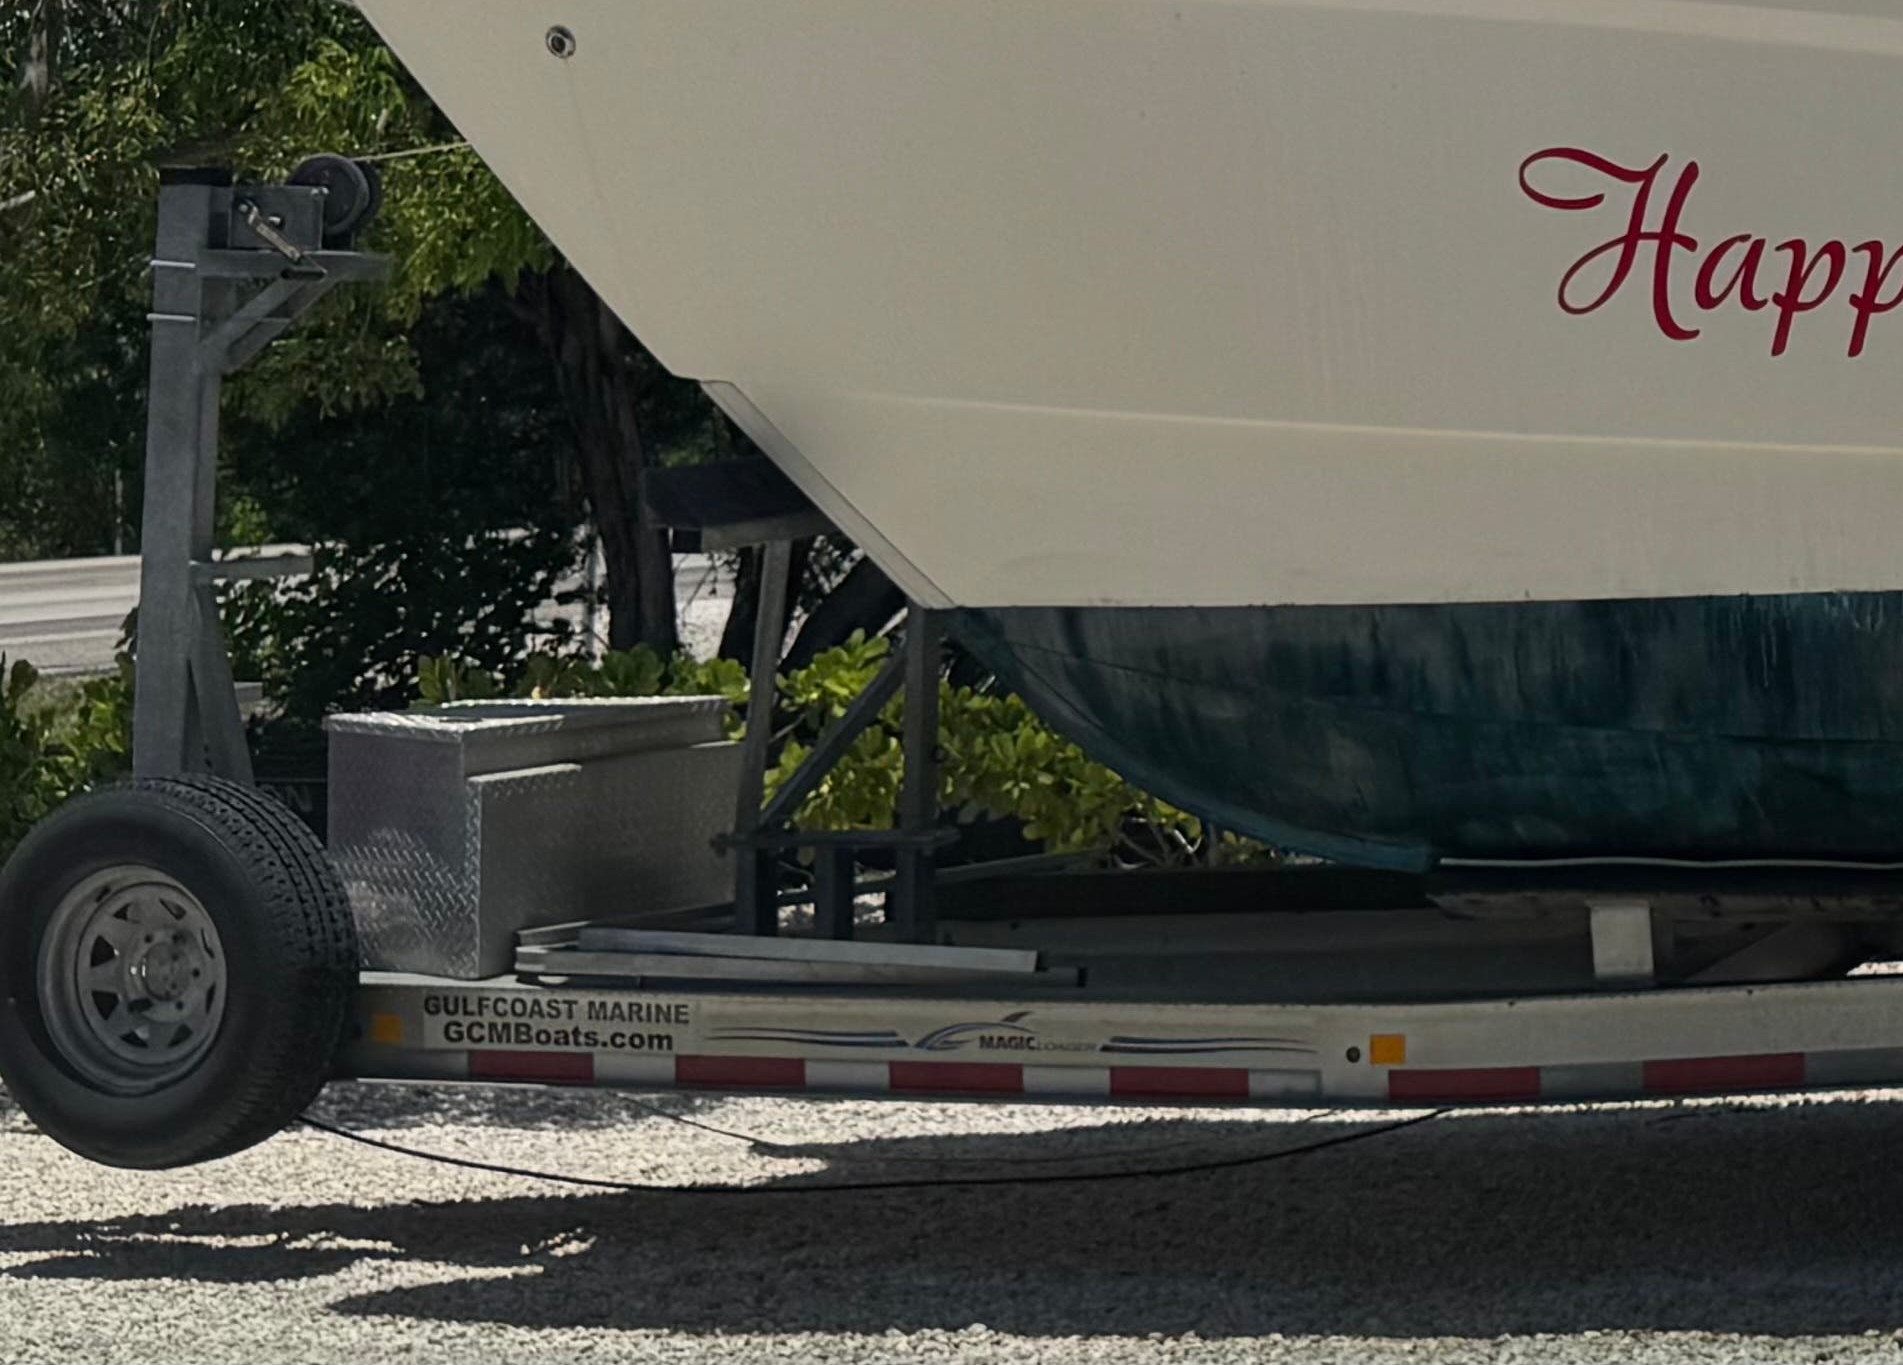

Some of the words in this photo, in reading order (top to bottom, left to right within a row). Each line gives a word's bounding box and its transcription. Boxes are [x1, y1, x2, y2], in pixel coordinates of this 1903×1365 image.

[424, 996, 578, 1020] GULFCOAST
[587, 1000, 690, 1025] MARINE
[443, 1021, 673, 1050] GCMBoats.com
